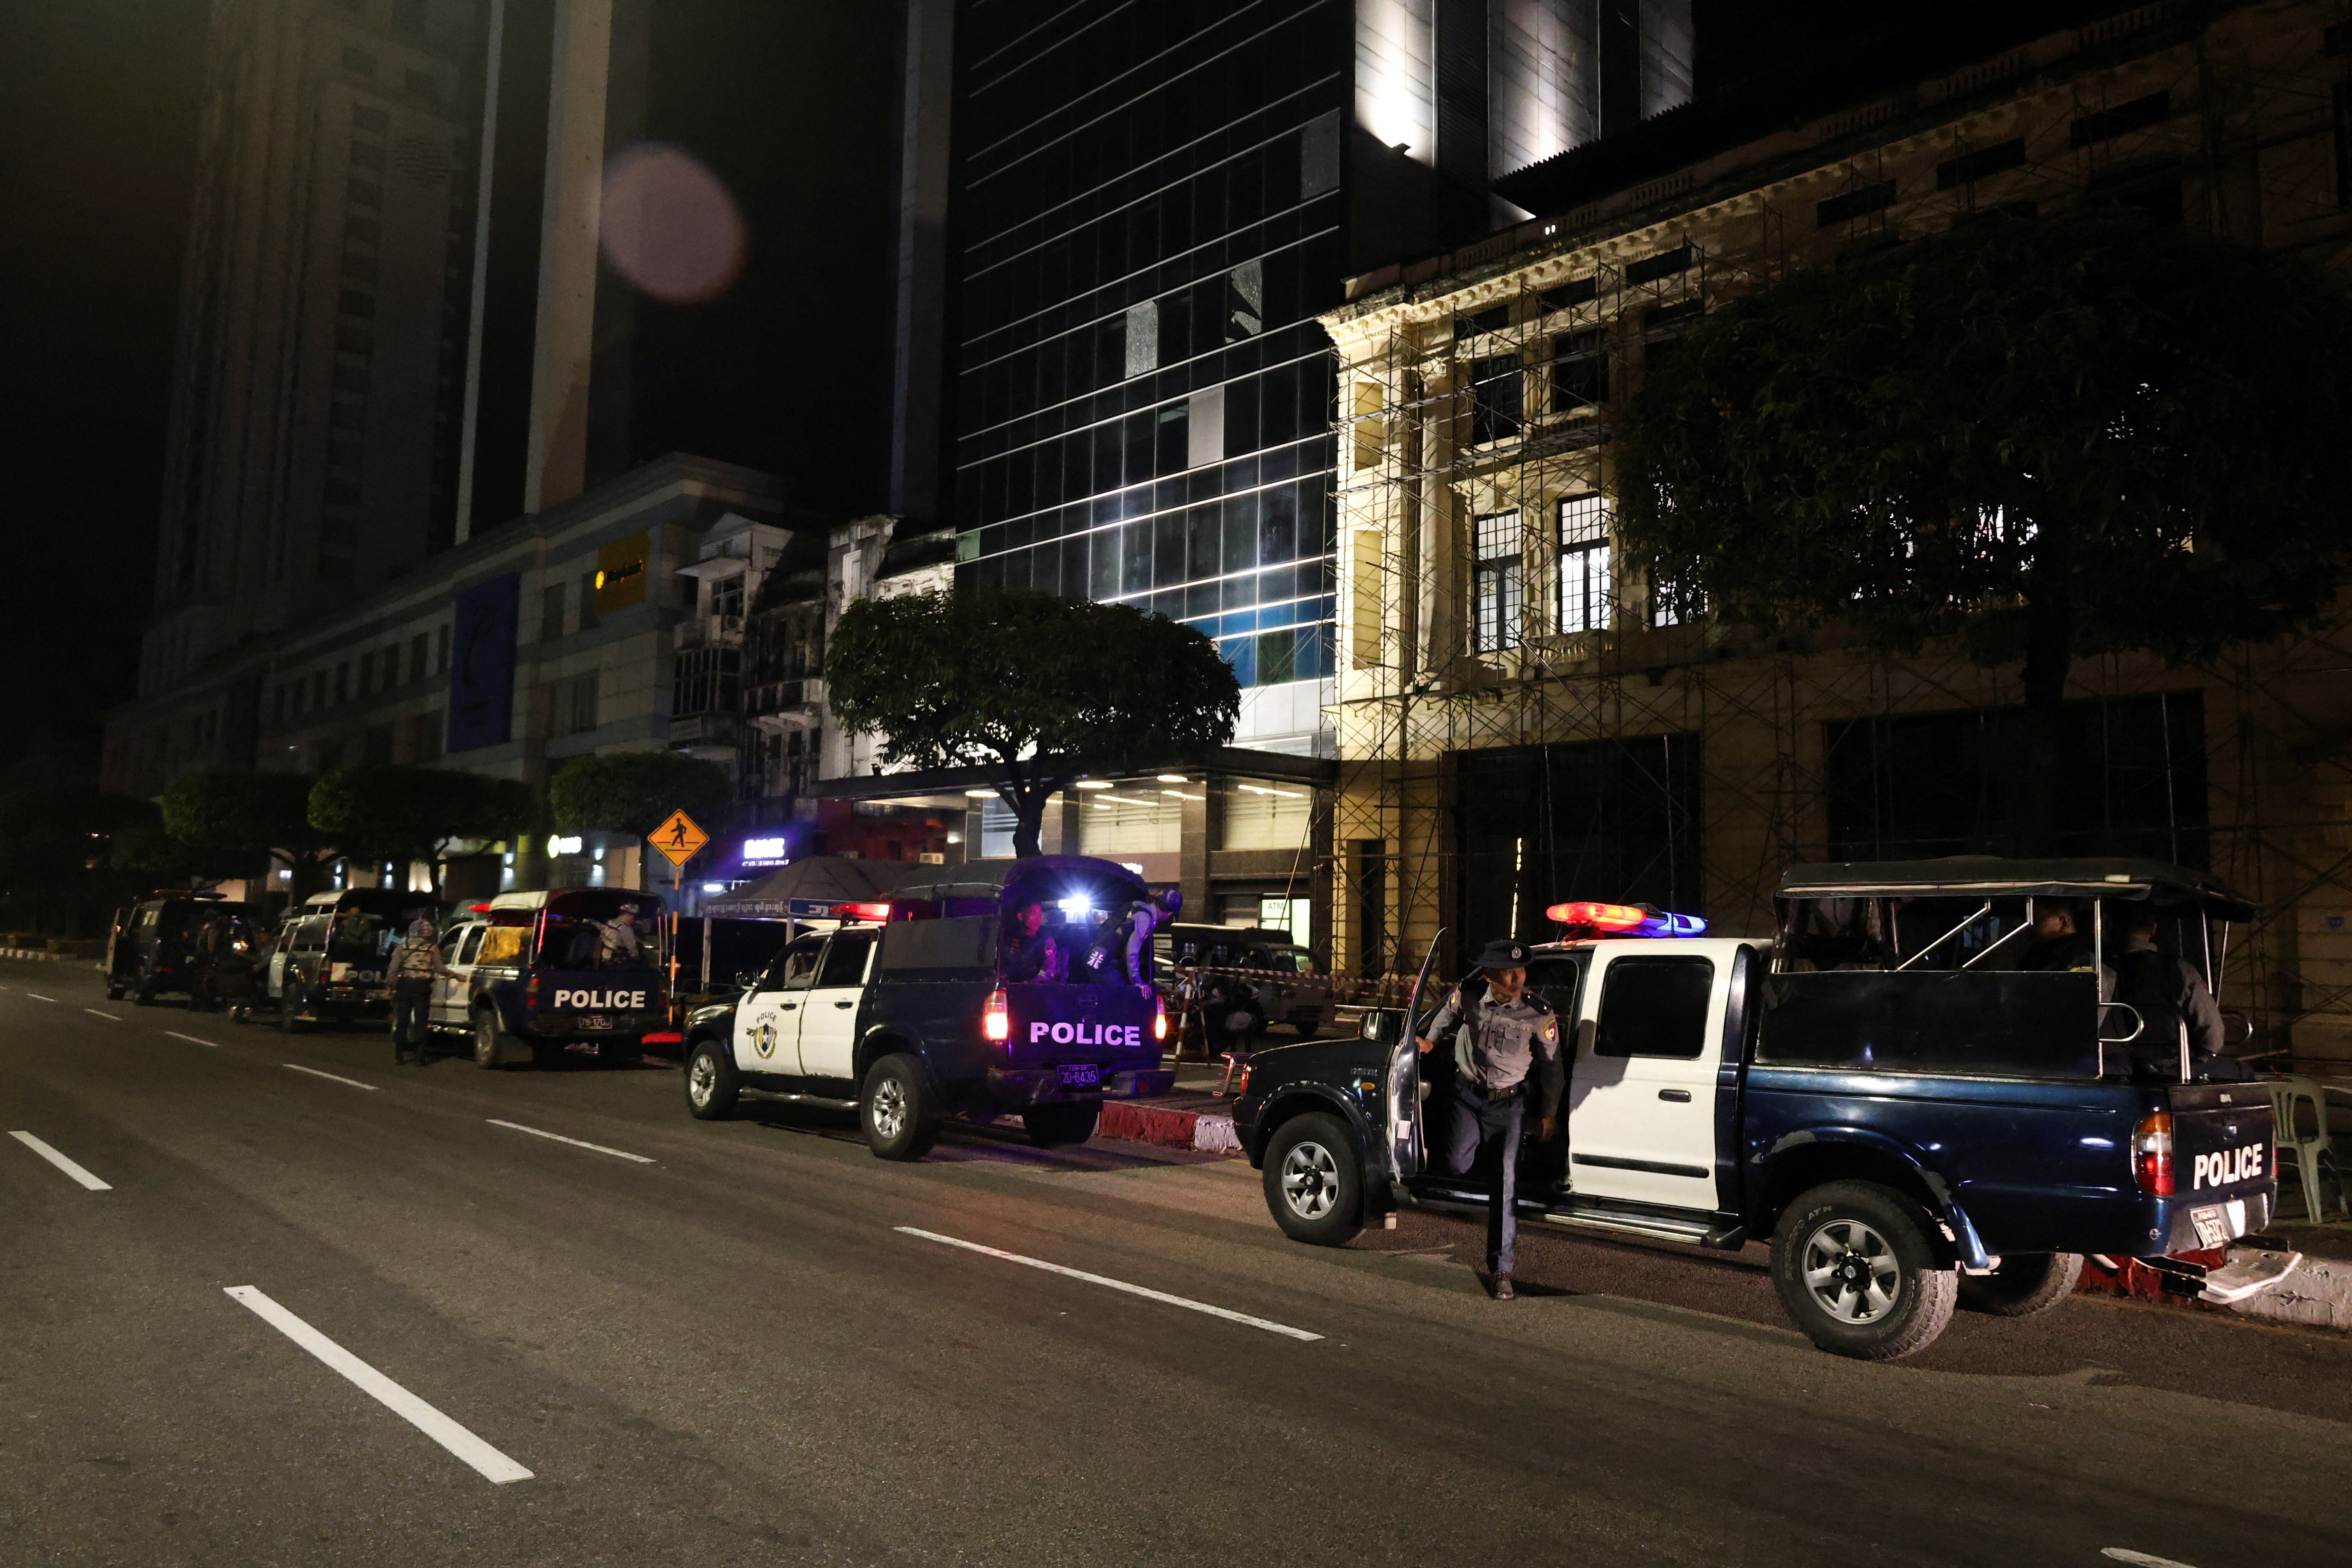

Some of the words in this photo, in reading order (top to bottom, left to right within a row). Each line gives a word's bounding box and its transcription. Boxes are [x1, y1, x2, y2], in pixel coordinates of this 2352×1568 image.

[344, 970, 386, 983] POL
[555, 989, 646, 1008] POLICE
[756, 1011, 777, 1024] POLICE
[1031, 1022, 1141, 1046] POLICE
[1061, 1071, 1096, 1083] 2D-6435
[2193, 1143, 2263, 1190] POLICE
